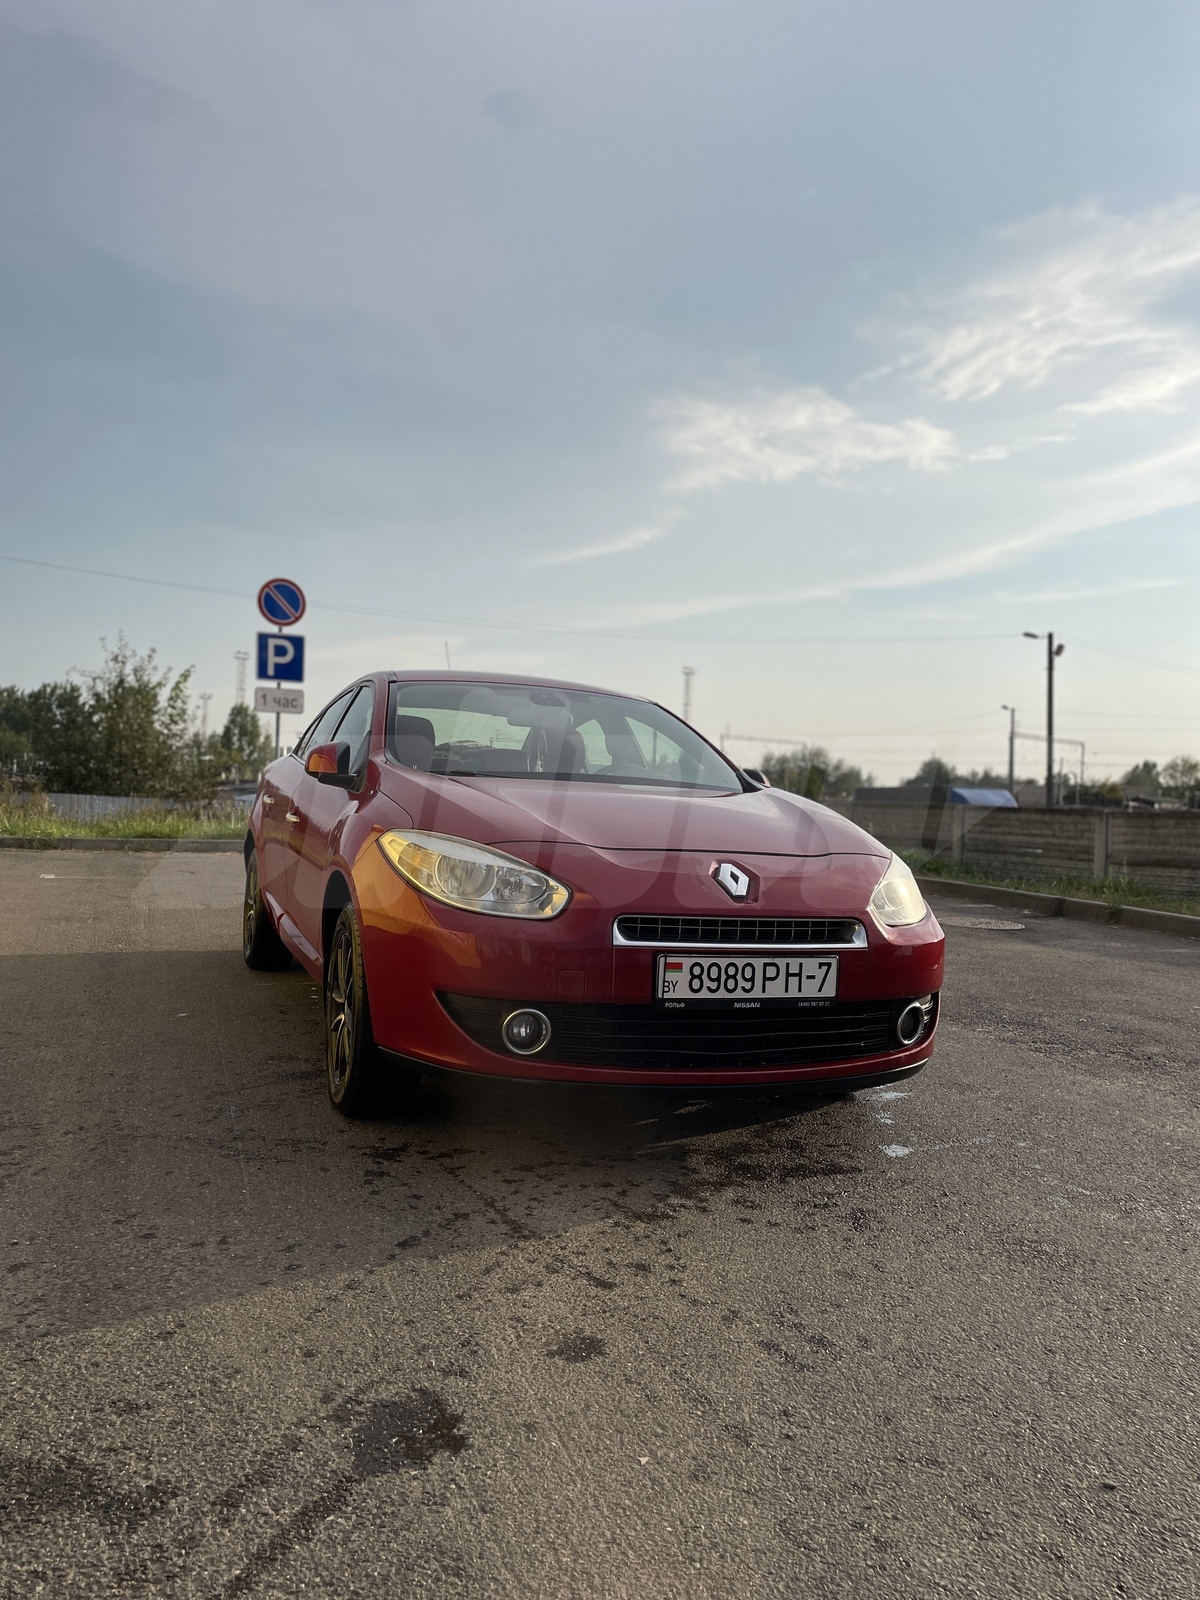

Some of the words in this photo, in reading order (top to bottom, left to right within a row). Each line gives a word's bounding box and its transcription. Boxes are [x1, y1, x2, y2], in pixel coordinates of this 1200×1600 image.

[267, 637, 295, 677] P
[261, 694, 267, 707] 1
[273, 696, 299, 709] час
